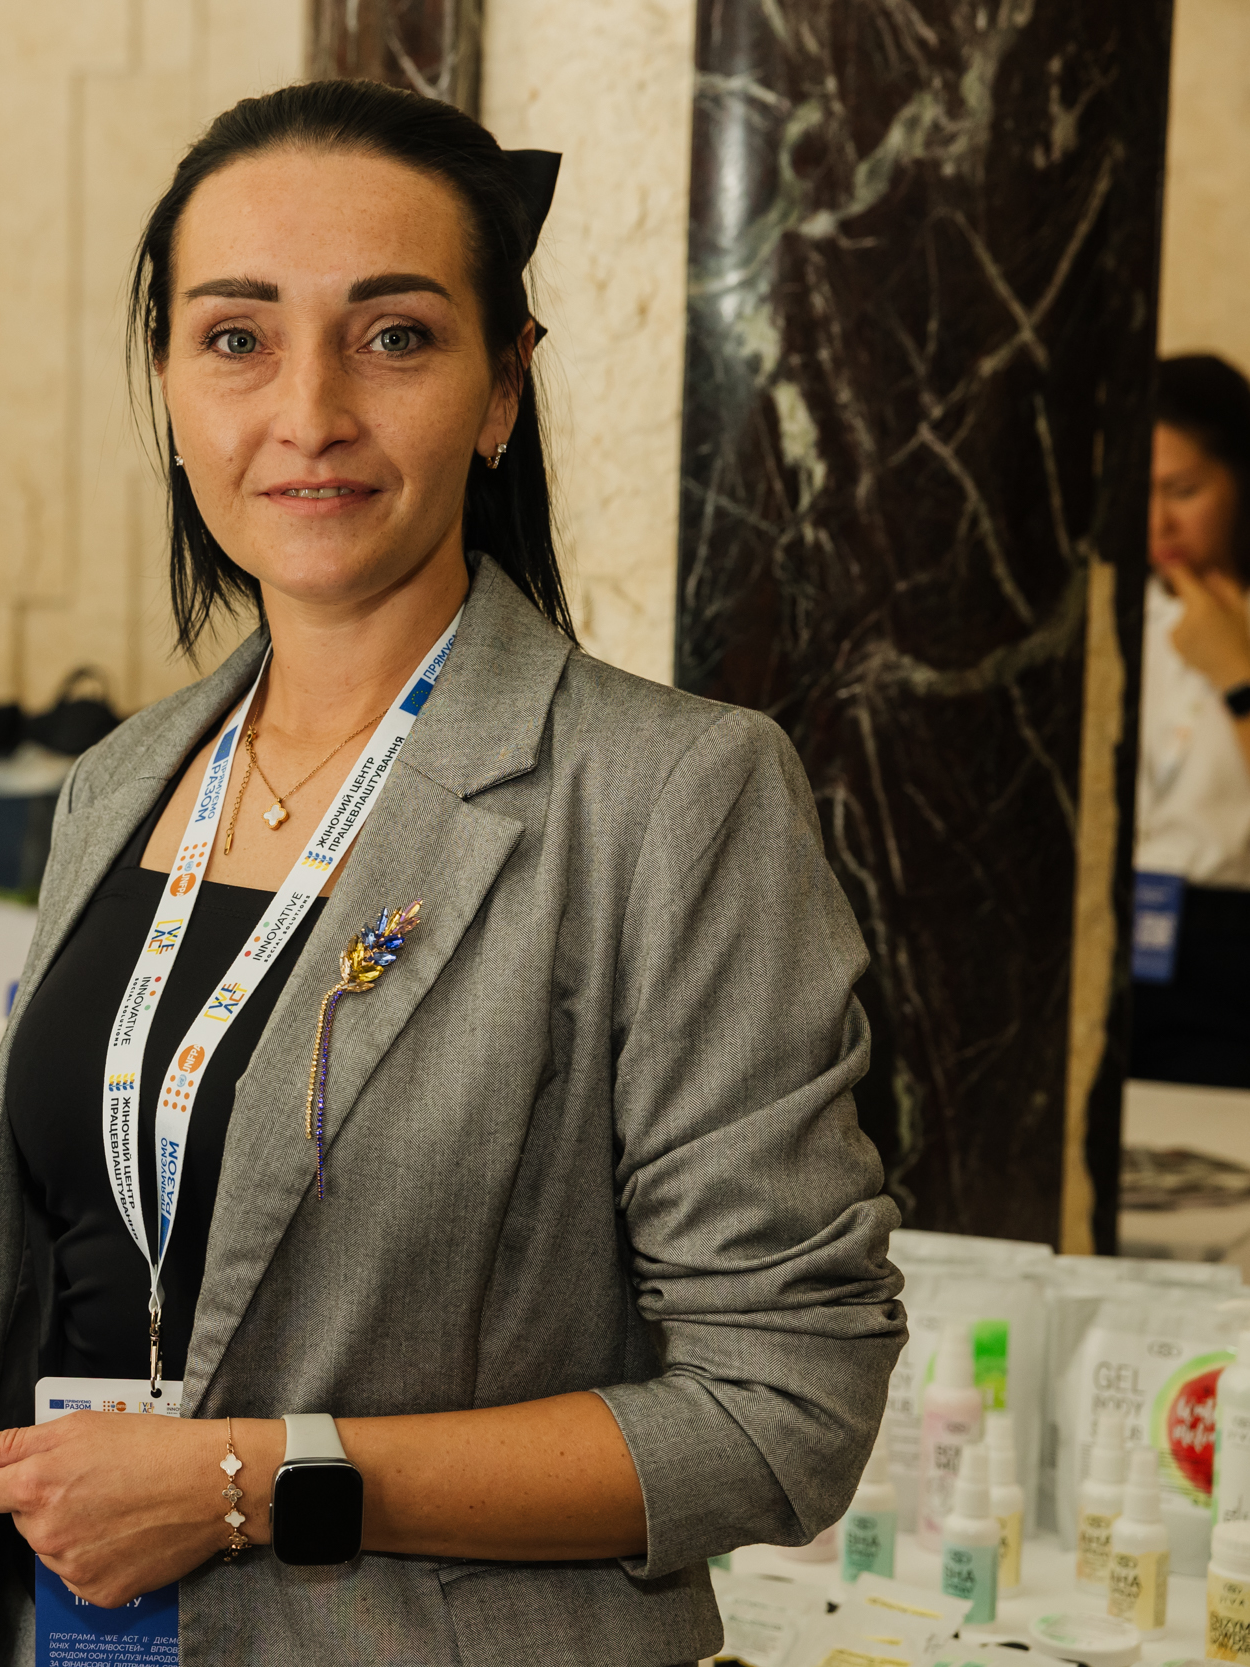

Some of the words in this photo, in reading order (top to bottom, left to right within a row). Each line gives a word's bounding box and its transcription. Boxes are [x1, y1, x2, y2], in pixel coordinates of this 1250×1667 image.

[423, 634, 456, 679] ПРЯМУЄ
[195, 763, 222, 822] РАЗОМ
[207, 759, 229, 819] ПРЯМУЄМО
[316, 794, 353, 848] ЖІНОЧИЙ
[350, 757, 375, 794] ЦЕНТР
[328, 736, 405, 851] ПРАЦЕВЛАШТУВАННЯ
[176, 873, 191, 897] UNFPA
[147, 929, 166, 955] ACT
[159, 925, 182, 954] WE
[253, 892, 303, 961] INNOVATIVE
[264, 938, 283, 962] SOCIAL
[282, 895, 310, 935] SOLUTIONS
[121, 976, 152, 1046] INNOVATIVE
[126, 977, 140, 1002] SOCIAL
[208, 982, 238, 1009] WE
[224, 983, 248, 1014] ACT
[113, 1005, 129, 1047] SOLUTIONS
[181, 1044, 202, 1074] UNFPA
[121, 1096, 132, 1162] ЖІНОЧИЙ
[109, 1097, 139, 1240] ПРАЦЕВЛАШТУВАННЯ
[123, 1164, 135, 1210] ЦЕНТР
[160, 1137, 168, 1211] ПРЯМУЄМО
[165, 1140, 179, 1216] РАЗОМ
[1093, 1361, 1145, 1396] GEL
[49, 1632, 96, 1641] ПРОГРАМА
[49, 1640, 70, 1649] ЇХНІХ
[75, 1642, 145, 1652] МОЖЛИВОСТЕЙ»
[150, 1645, 178, 1654] ВПРОВ
[49, 1650, 87, 1660] ФОНДОМ
[88, 1652, 107, 1660] ООН
[114, 1653, 142, 1661] ГАЛУЗІ
